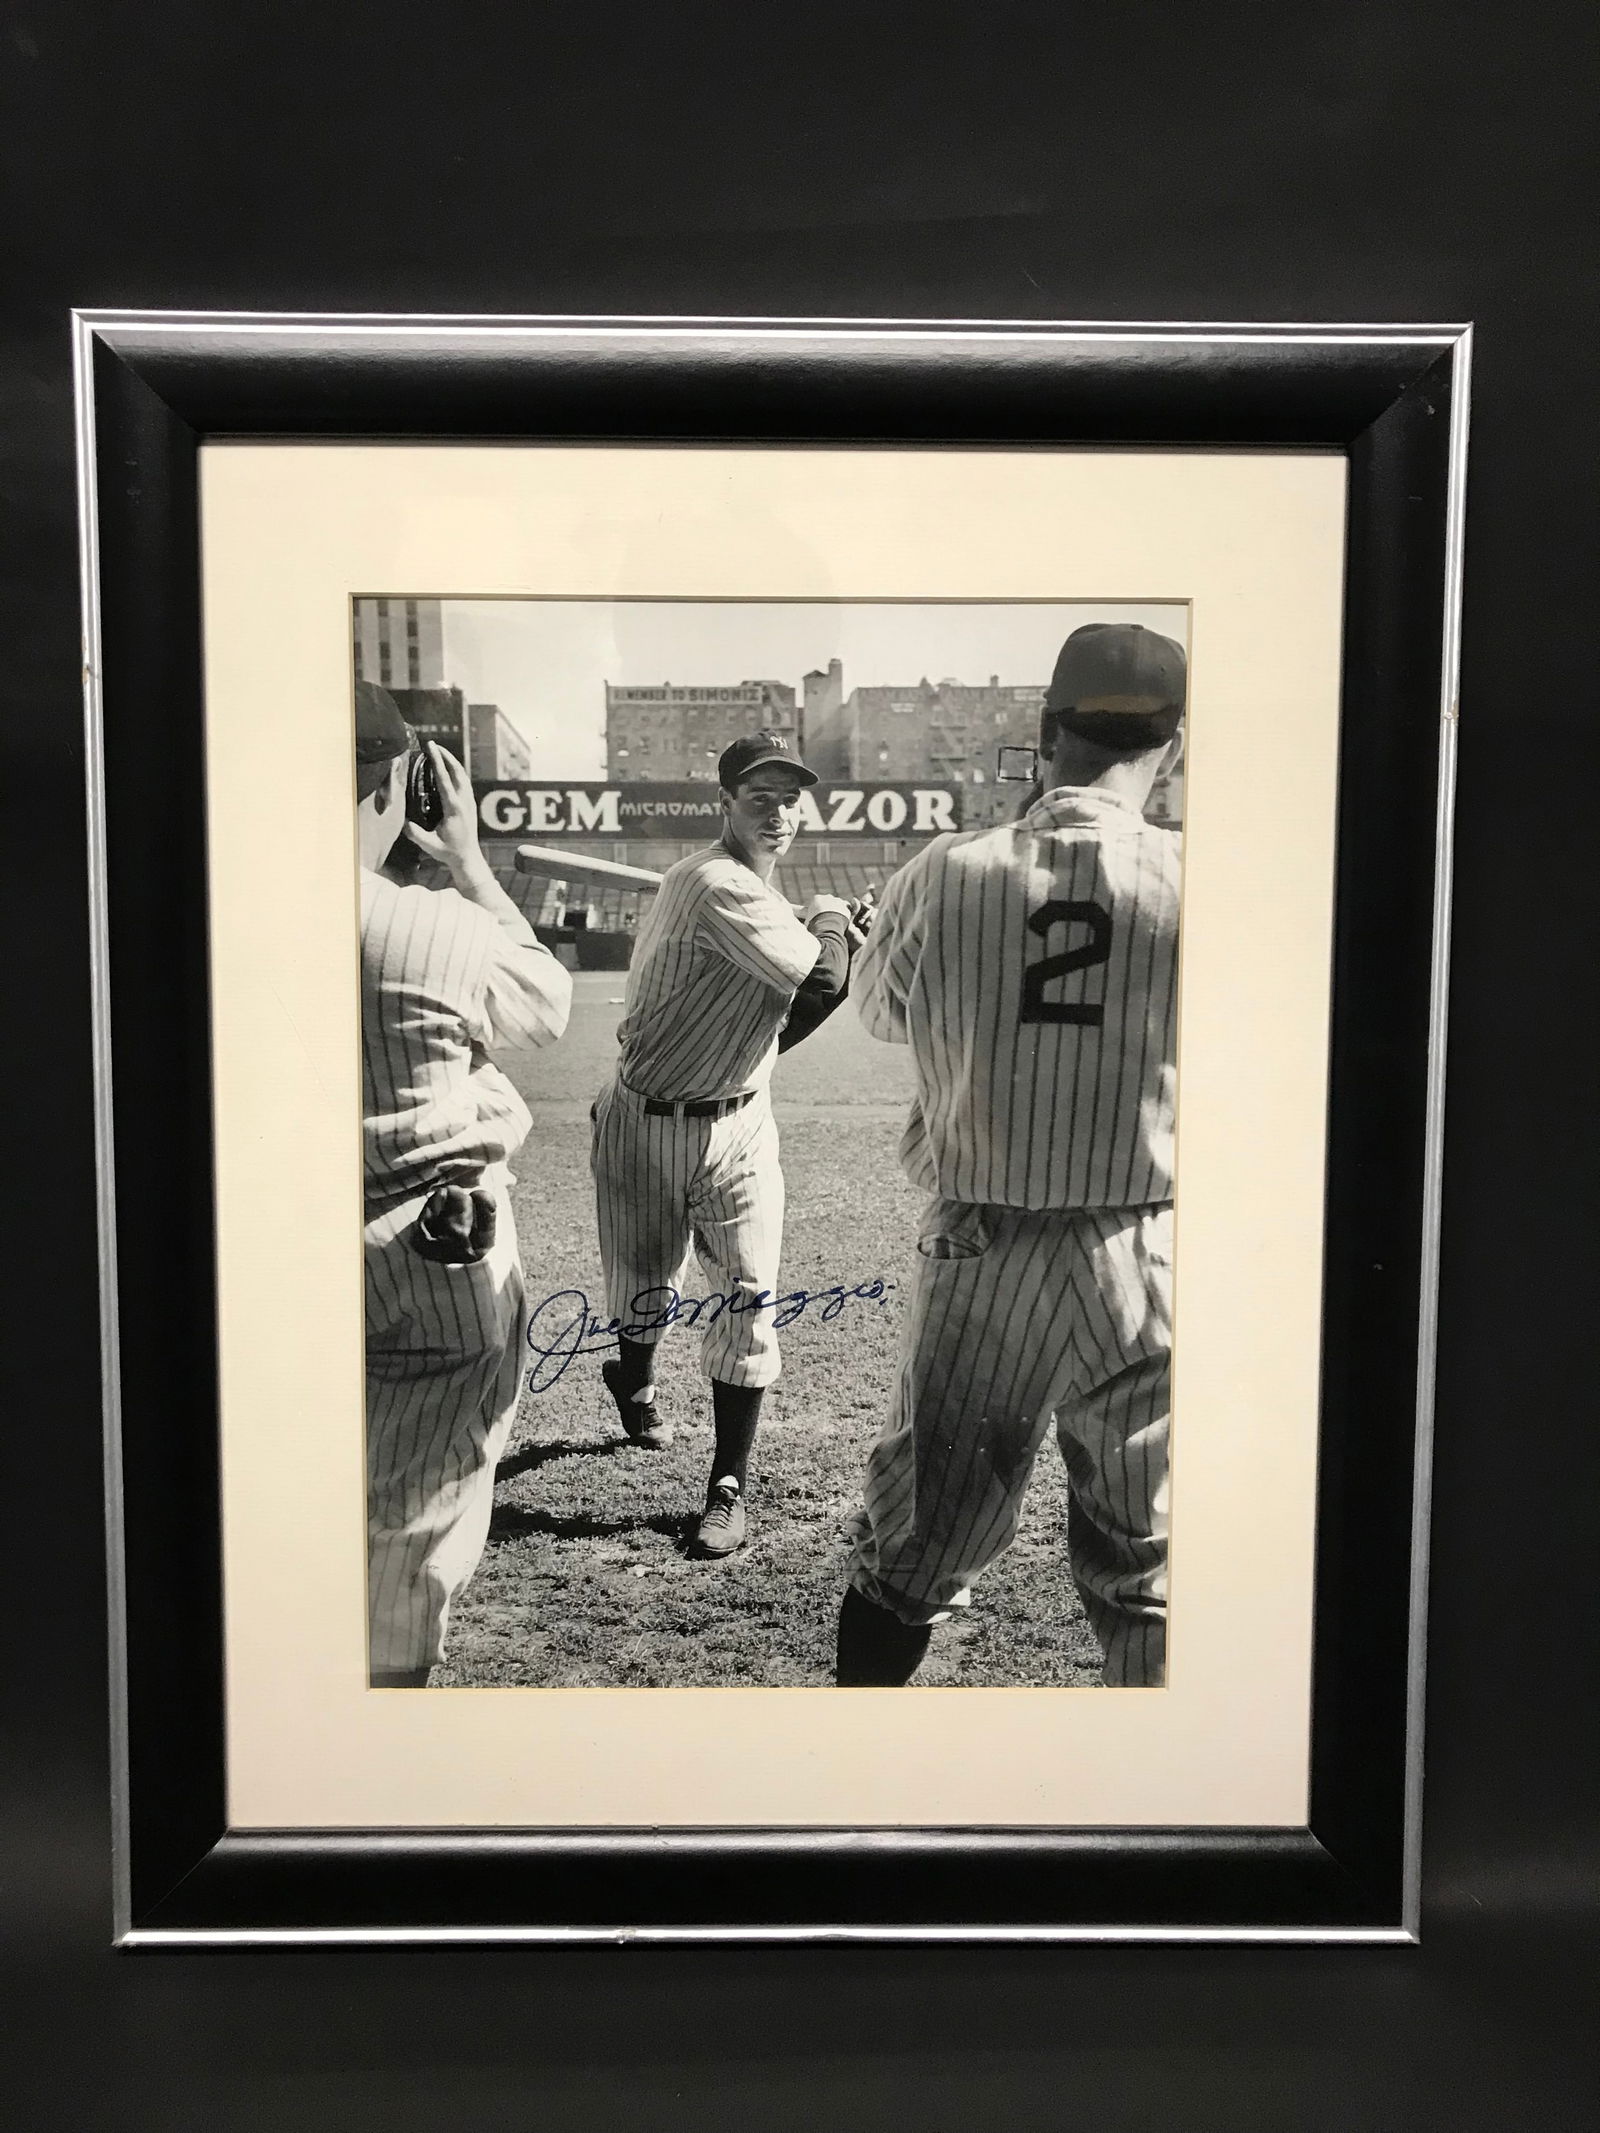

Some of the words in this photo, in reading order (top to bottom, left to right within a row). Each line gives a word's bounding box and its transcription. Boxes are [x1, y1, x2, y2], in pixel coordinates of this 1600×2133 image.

[481, 791, 622, 832] GEM
[619, 802, 721, 816] MICROMAT
[799, 790, 957, 832] AZOR
[1021, 900, 1114, 1026] 2
